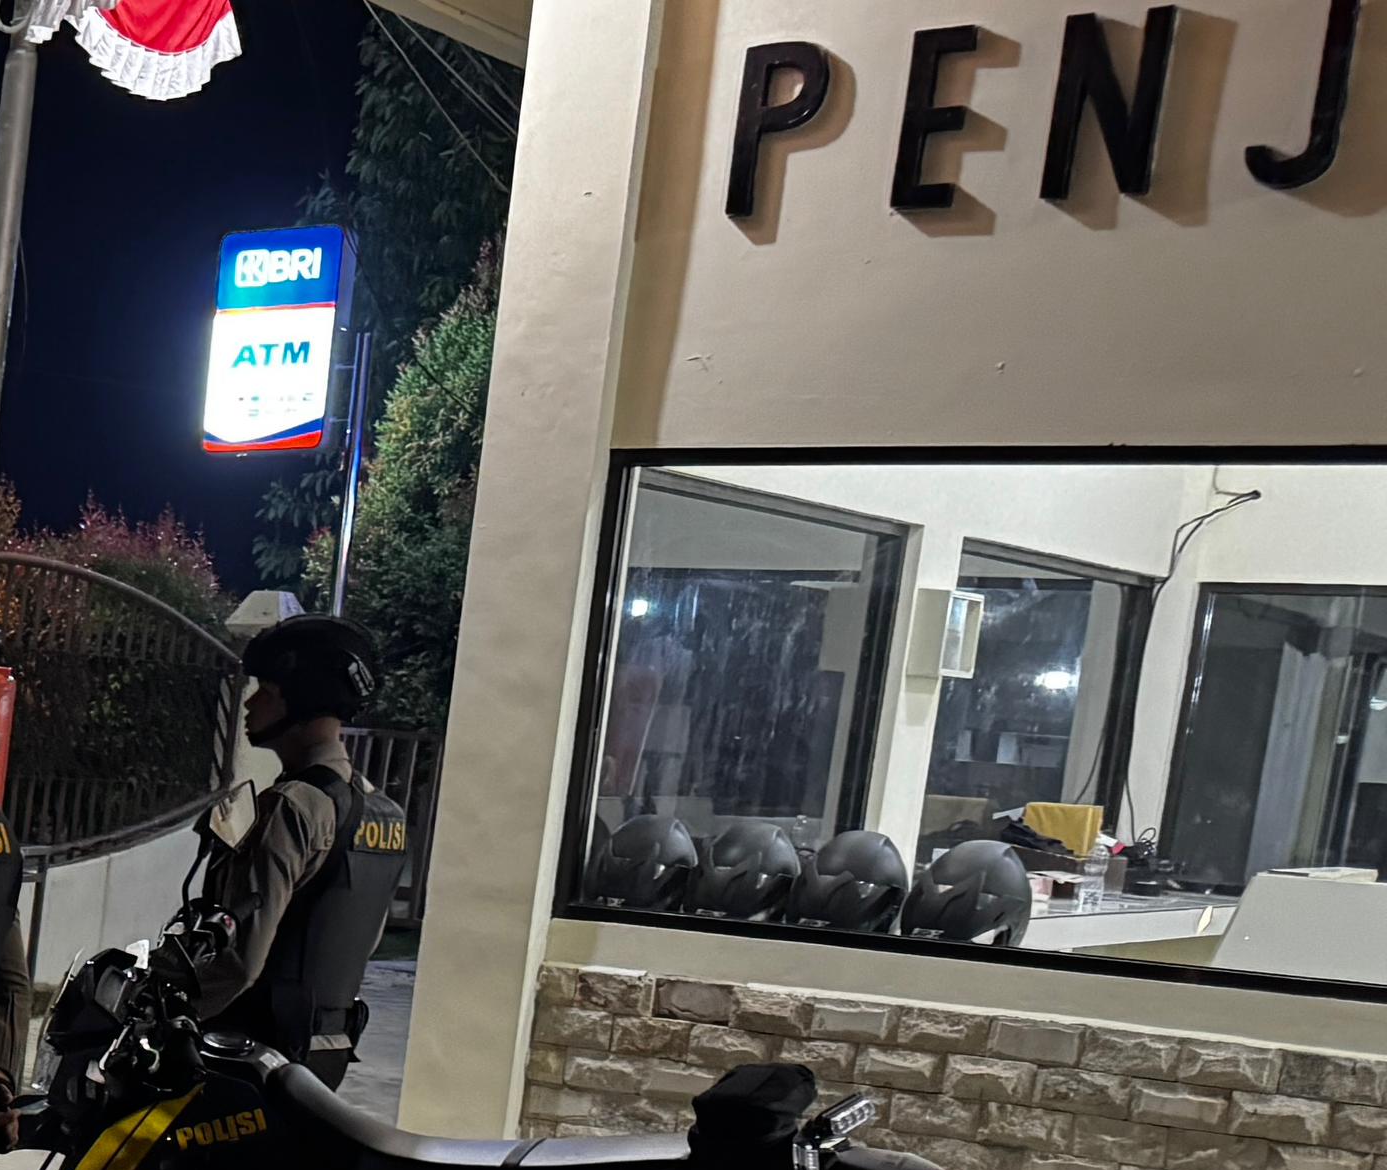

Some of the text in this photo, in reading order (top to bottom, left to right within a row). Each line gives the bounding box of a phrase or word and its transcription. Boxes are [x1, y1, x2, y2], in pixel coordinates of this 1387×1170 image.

[725, 0, 1360, 218] PENJ
[267, 247, 323, 284] BRI
[231, 341, 311, 369] ATM
[176, 1107, 268, 1150] POLISI
